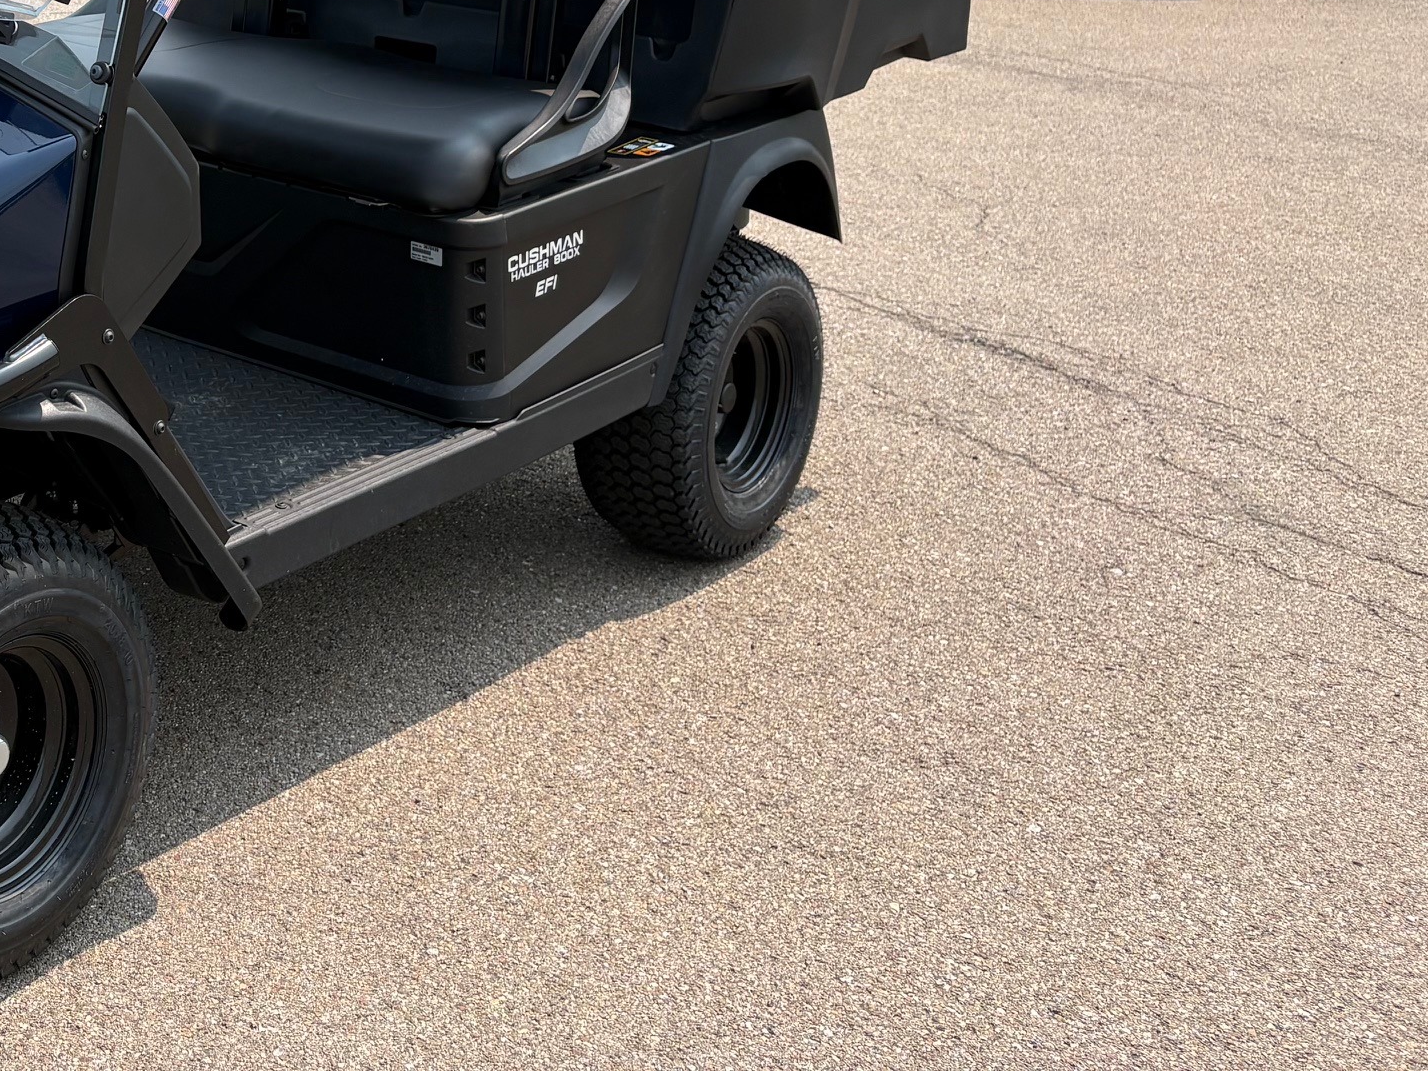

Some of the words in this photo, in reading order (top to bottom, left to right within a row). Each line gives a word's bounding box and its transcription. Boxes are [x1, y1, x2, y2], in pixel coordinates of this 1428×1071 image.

[508, 229, 584, 273] CUSHMAN
[511, 258, 550, 283] HAULER
[534, 273, 559, 298] EFI
